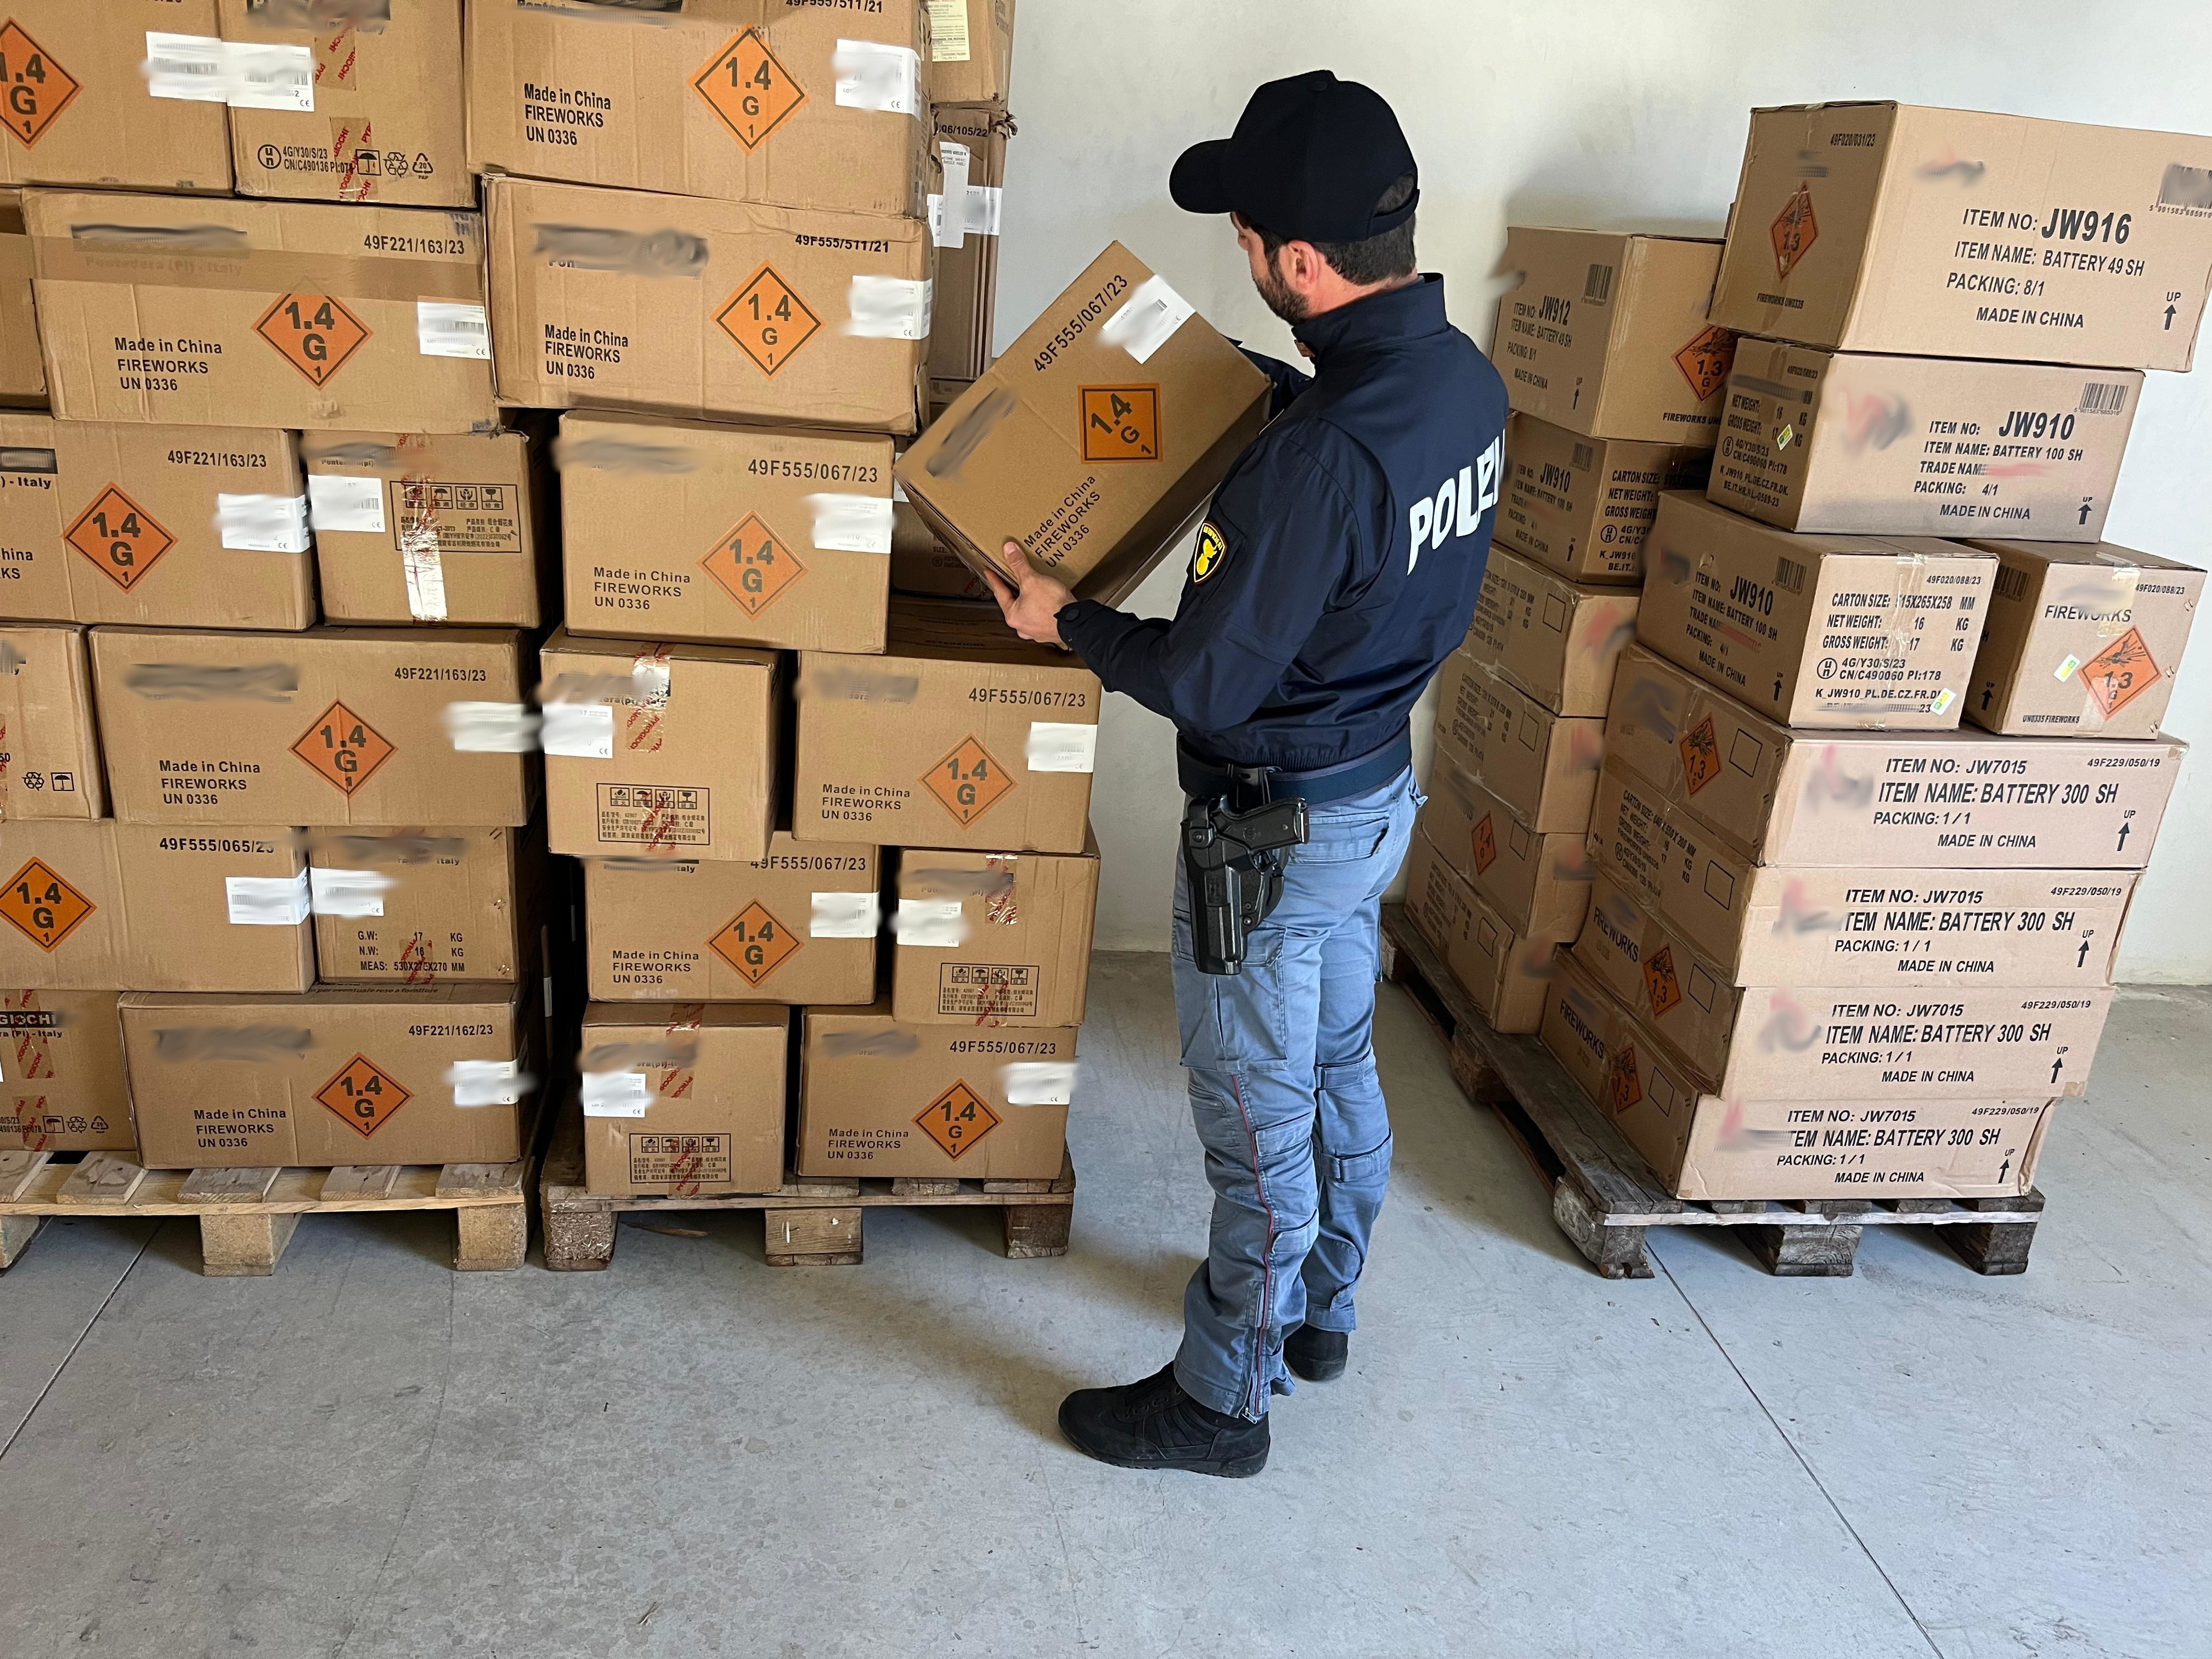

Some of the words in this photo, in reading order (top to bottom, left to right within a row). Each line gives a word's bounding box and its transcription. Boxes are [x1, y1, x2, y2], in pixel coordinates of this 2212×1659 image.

[726, 57, 771, 91] 1.4
[524, 83, 556, 103] Made
[560, 88, 571, 105] in
[574, 90, 611, 110] China
[742, 96, 759, 116] G
[524, 104, 603, 128] FIREWORKS
[526, 126, 545, 143] UN
[548, 128, 578, 146] 0336
[1962, 208, 2005, 228] ITEM
[2007, 213, 2038, 231] NO:
[2041, 208, 2132, 245] JW916
[364, 234, 465, 255] 49F221/163/23
[1955, 241, 1990, 261] ITEM
[1991, 245, 2036, 265] NAME:
[2042, 250, 2107, 273] BATTERY
[2108, 257, 2123, 274] 49
[2125, 259, 2145, 276] SH
[1946, 272, 2021, 295] PACKING:
[2023, 279, 2045, 296] 8/1
[2166, 291, 2181, 302] UP
[285, 302, 335, 330] 1.4
[748, 294, 791, 321] 1.4
[1539, 295, 1571, 326] JW912
[1976, 307, 2018, 323] MADE
[2021, 309, 2036, 324] IN
[2039, 311, 2084, 328] CHINA
[1033, 274, 1129, 373] 49F555/067/23
[115, 337, 155, 351] Made
[159, 338, 173, 352] in
[177, 339, 222, 354] China
[761, 328, 778, 346] G
[303, 334, 328, 361] G
[117, 359, 208, 374] FIREWORKS
[313, 366, 322, 379] 1
[1697, 359, 1724, 377] 1.3
[120, 377, 141, 390] UN
[145, 378, 178, 391] 0336
[1701, 377, 1710, 387] G
[1091, 393, 1133, 435] 1.4
[1662, 412, 1707, 425] FIREWORKS
[1120, 426, 1140, 444] G
[1929, 421, 1956, 434] ITEM
[1960, 422, 1980, 435] NO:
[1999, 411, 2075, 440] JW910
[167, 449, 267, 468] 49F221/163/23
[1141, 444, 1152, 455] 1
[1924, 441, 1951, 454] ITEM
[1955, 443, 1990, 456] NAME:
[1993, 444, 2042, 459] BATTERY
[2045, 447, 2064, 460] 100
[2067, 449, 2083, 461] SH
[748, 459, 878, 483] 49F555/067/23
[1540, 462, 1571, 493] JW910
[1612, 470, 1641, 484] CARTON
[1920, 461, 1955, 475] TRADE
[18, 477, 52, 490] Italy
[1914, 481, 1966, 494] PACKING:
[1982, 483, 1998, 496] 4/1
[1023, 516, 1055, 548] Made
[1050, 506, 1065, 522] in
[1063, 474, 1097, 509] China
[1605, 505, 1628, 518] GROSS
[1939, 504, 1976, 517] MADE
[1978, 505, 1991, 518] IN
[1993, 506, 2030, 520] CHINA
[92, 512, 141, 539] 1.4
[1034, 491, 1101, 559] FIREWORKS
[110, 541, 134, 567] G
[729, 539, 775, 566] 1.4
[1045, 548, 1065, 568] UN
[1060, 523, 1091, 556] 0336
[742, 568, 763, 593] G
[1730, 575, 1774, 616] JW910
[1832, 593, 1867, 607] CARTON
[1868, 594, 1891, 608] SIZE:
[1959, 596, 1975, 610] MM
[1726, 606, 1754, 629] BATTERY
[1756, 620, 1766, 635] 100
[1768, 627, 1778, 641] SH
[1827, 614, 1845, 628] NET
[1846, 615, 1882, 629] WEIGHT:
[1914, 617, 1925, 630] 16
[1956, 618, 1969, 631] KG
[1686, 623, 1713, 647] PACKING:
[1822, 635, 1852, 649] GROSS
[1853, 636, 1888, 650] WEIGHT:
[1909, 637, 1920, 651] 17
[1950, 639, 1964, 652] KG
[1699, 650, 1716, 668] MADE
[1717, 661, 1724, 674] IN
[1725, 665, 1746, 687] CHINA
[1842, 657, 1906, 669] 4G/Y30/S/23
[394, 667, 487, 682] 49F221/163/23
[1839, 669, 1904, 681] CN/C490060
[1906, 670, 1942, 680] PI:178
[2104, 671, 2133, 689] 1.3
[968, 687, 1086, 708] 49F555/067/23
[2045, 715, 2080, 724] FIREWORKS
[320, 725, 366, 749] 1.4
[334, 750, 357, 772] G
[947, 758, 988, 782] 1.4
[1886, 758, 1926, 774] ITEM
[1929, 758, 1960, 774] NO:
[1965, 760, 2027, 775] JW7015
[2087, 758, 2160, 768] 49F229/050/19
[957, 783, 976, 806] G
[1878, 782, 1917, 803] ITEM
[1924, 783, 1978, 804] NAME:
[1979, 783, 2059, 805] BATTERY
[2061, 784, 2089, 805] 300
[2095, 783, 2119, 804] SH
[1874, 811, 1939, 826] PACKING:
[2124, 810, 2136, 819] UP
[1937, 834, 1976, 848] MADE
[1978, 834, 1993, 848] IN
[1996, 834, 2037, 849] CHINA
[16, 882, 62, 905] 1.4
[1923, 890, 1983, 904] JW7015
[2050, 886, 2122, 896] 49F229/050/19
[33, 907, 55, 929] G
[358, 931, 377, 940] G.W:
[414, 932, 423, 941] 17
[450, 932, 463, 943] KG
[1593, 906, 1639, 963] FIREWORKS
[359, 946, 379, 956] N.W:
[415, 946, 425, 956] 16
[452, 947, 464, 957] KG
[360, 961, 387, 971] MEAS:
[452, 962, 465, 972] MM
[2021, 1000, 2091, 1009] 49F229/050/19
[408, 1024, 493, 1036] 49F221/162/23
[1560, 999, 1605, 1060] FIREWORKS
[950, 1040, 1057, 1055] 49F555/067/23
[1860, 1109, 1916, 1122] JW7015
